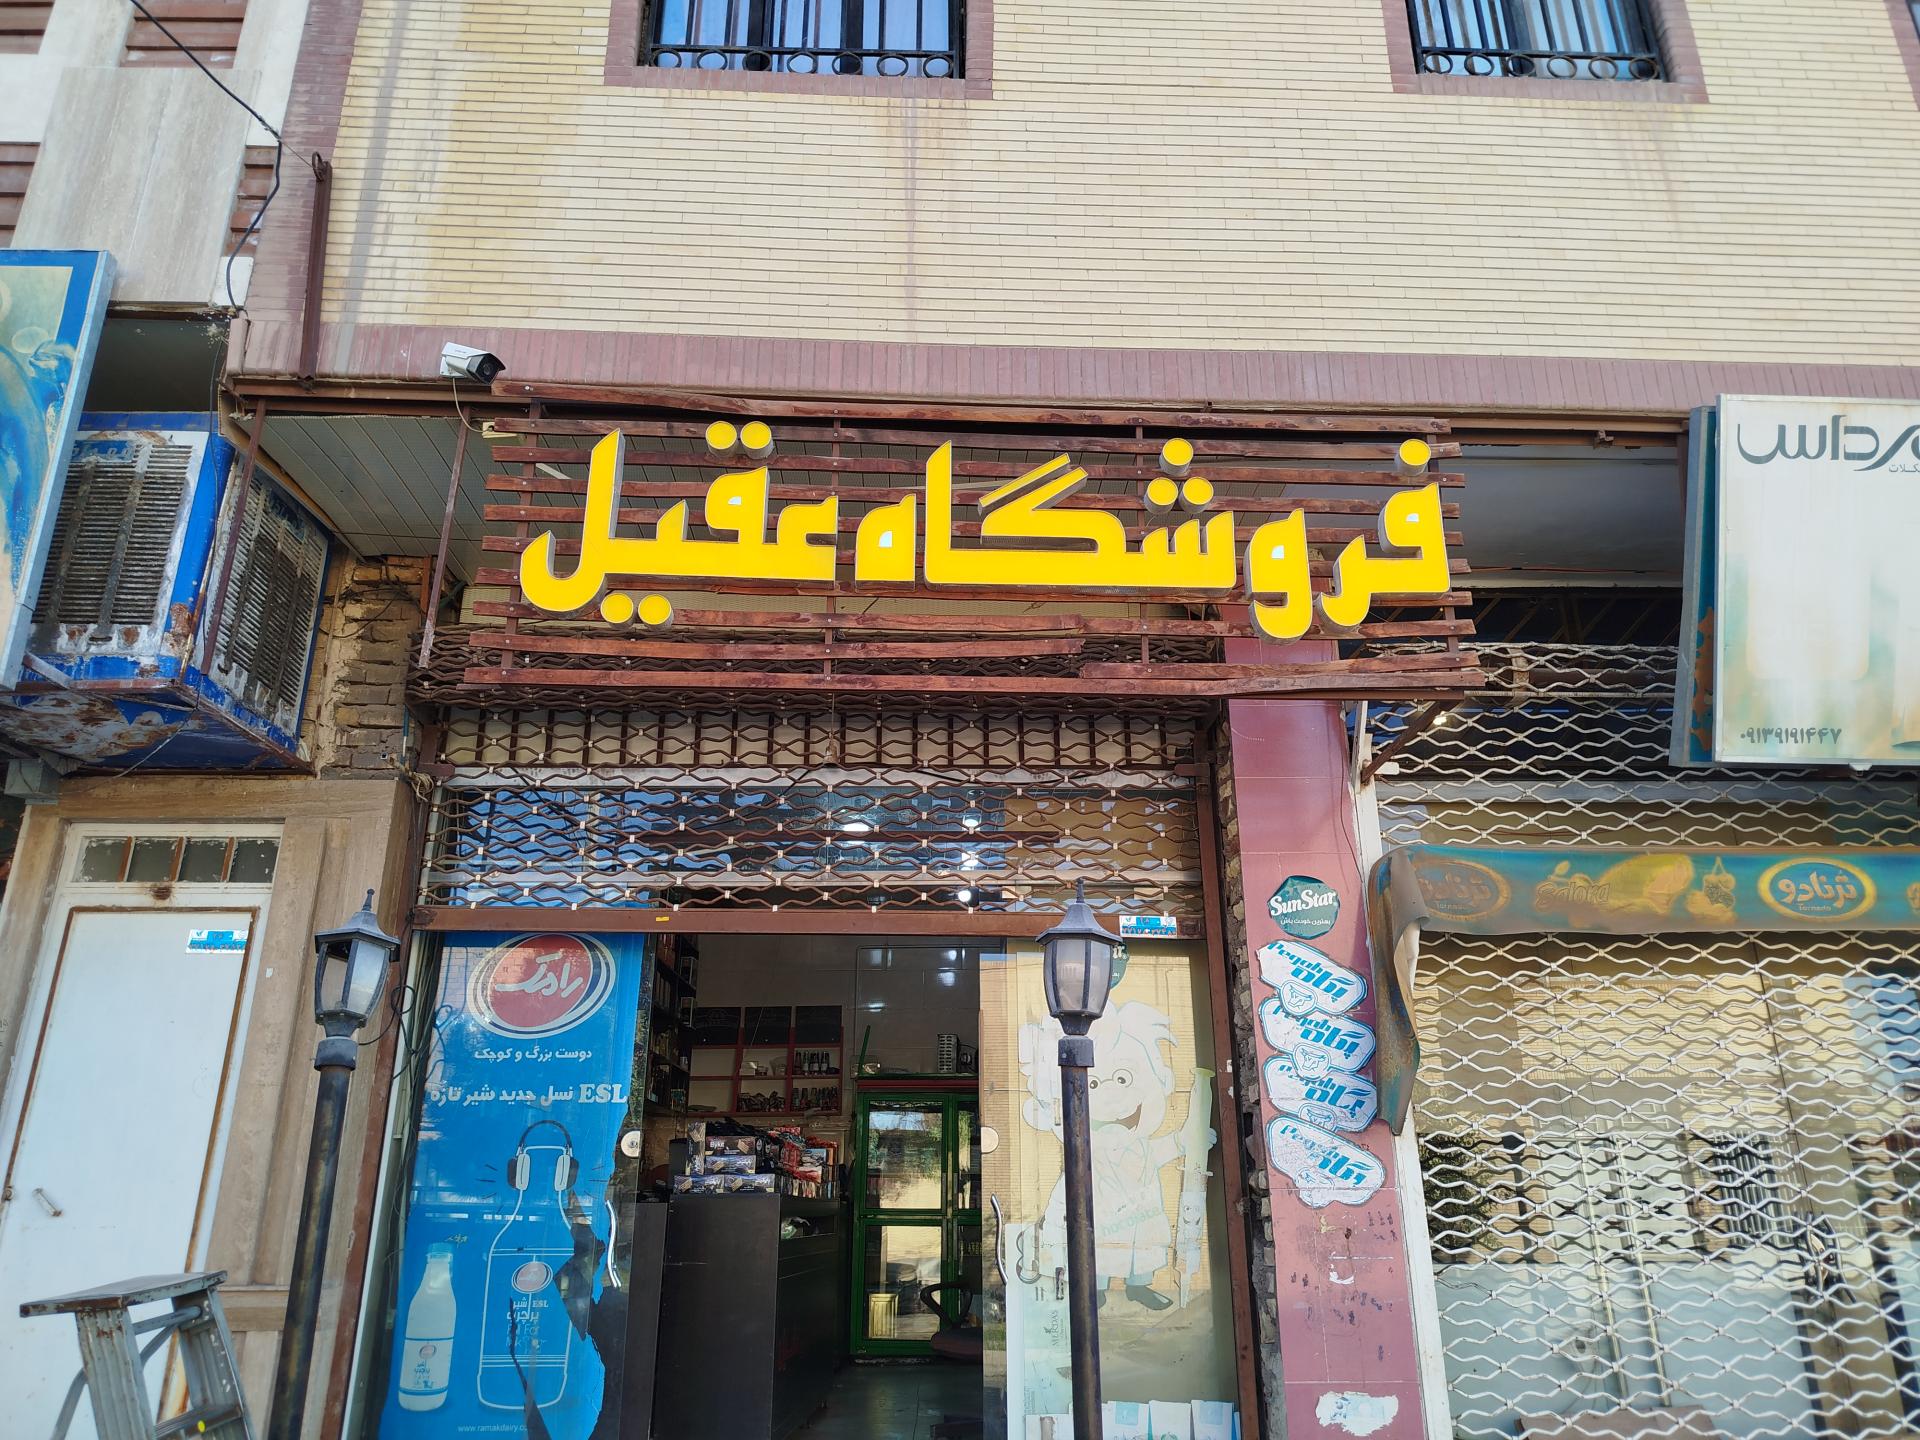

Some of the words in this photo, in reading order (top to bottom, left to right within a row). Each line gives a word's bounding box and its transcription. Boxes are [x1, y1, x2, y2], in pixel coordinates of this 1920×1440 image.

[520, 420, 838, 628] عقیل
[856, 437, 1452, 642] فروشگاه
[1269, 889, 1336, 916] SunStar
[474, 1048, 511, 1063] کوچک
[515, 1052, 521, 1062] و
[525, 1046, 552, 1062] بزرگ
[555, 1048, 592, 1062] دوست
[430, 1086, 462, 1107] تازه
[463, 1084, 496, 1106] شیر
[499, 1088, 537, 1105] جدید
[540, 1085, 574, 1106] نسل
[578, 1084, 627, 1104] ESL
